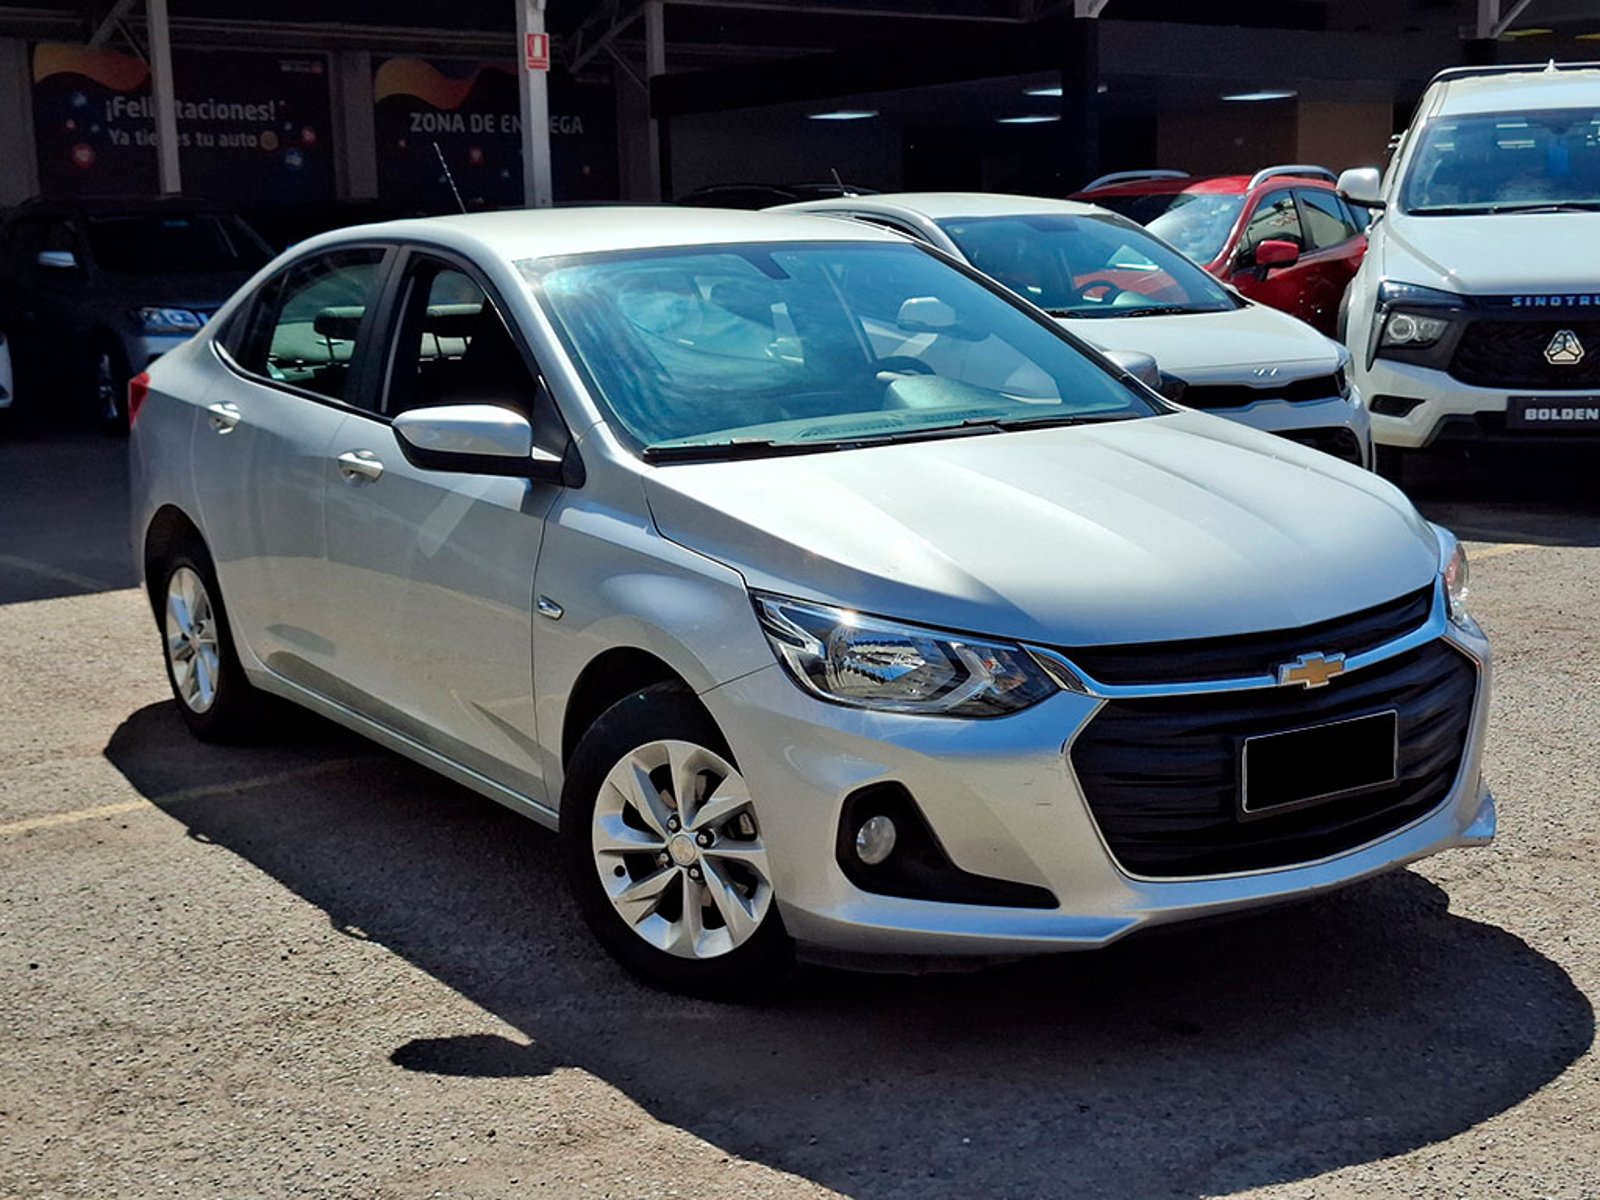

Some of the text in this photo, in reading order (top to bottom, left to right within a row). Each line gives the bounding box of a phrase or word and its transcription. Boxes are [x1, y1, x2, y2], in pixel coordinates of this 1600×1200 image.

[105, 95, 276, 122] ¡Felitaciones!
[409, 112, 584, 134] ZONA DE ENEGA
[107, 128, 130, 145] Ya
[195, 131, 214, 147] tu
[218, 132, 258, 148] auto
[1524, 408, 1599, 420] BOLDEN
